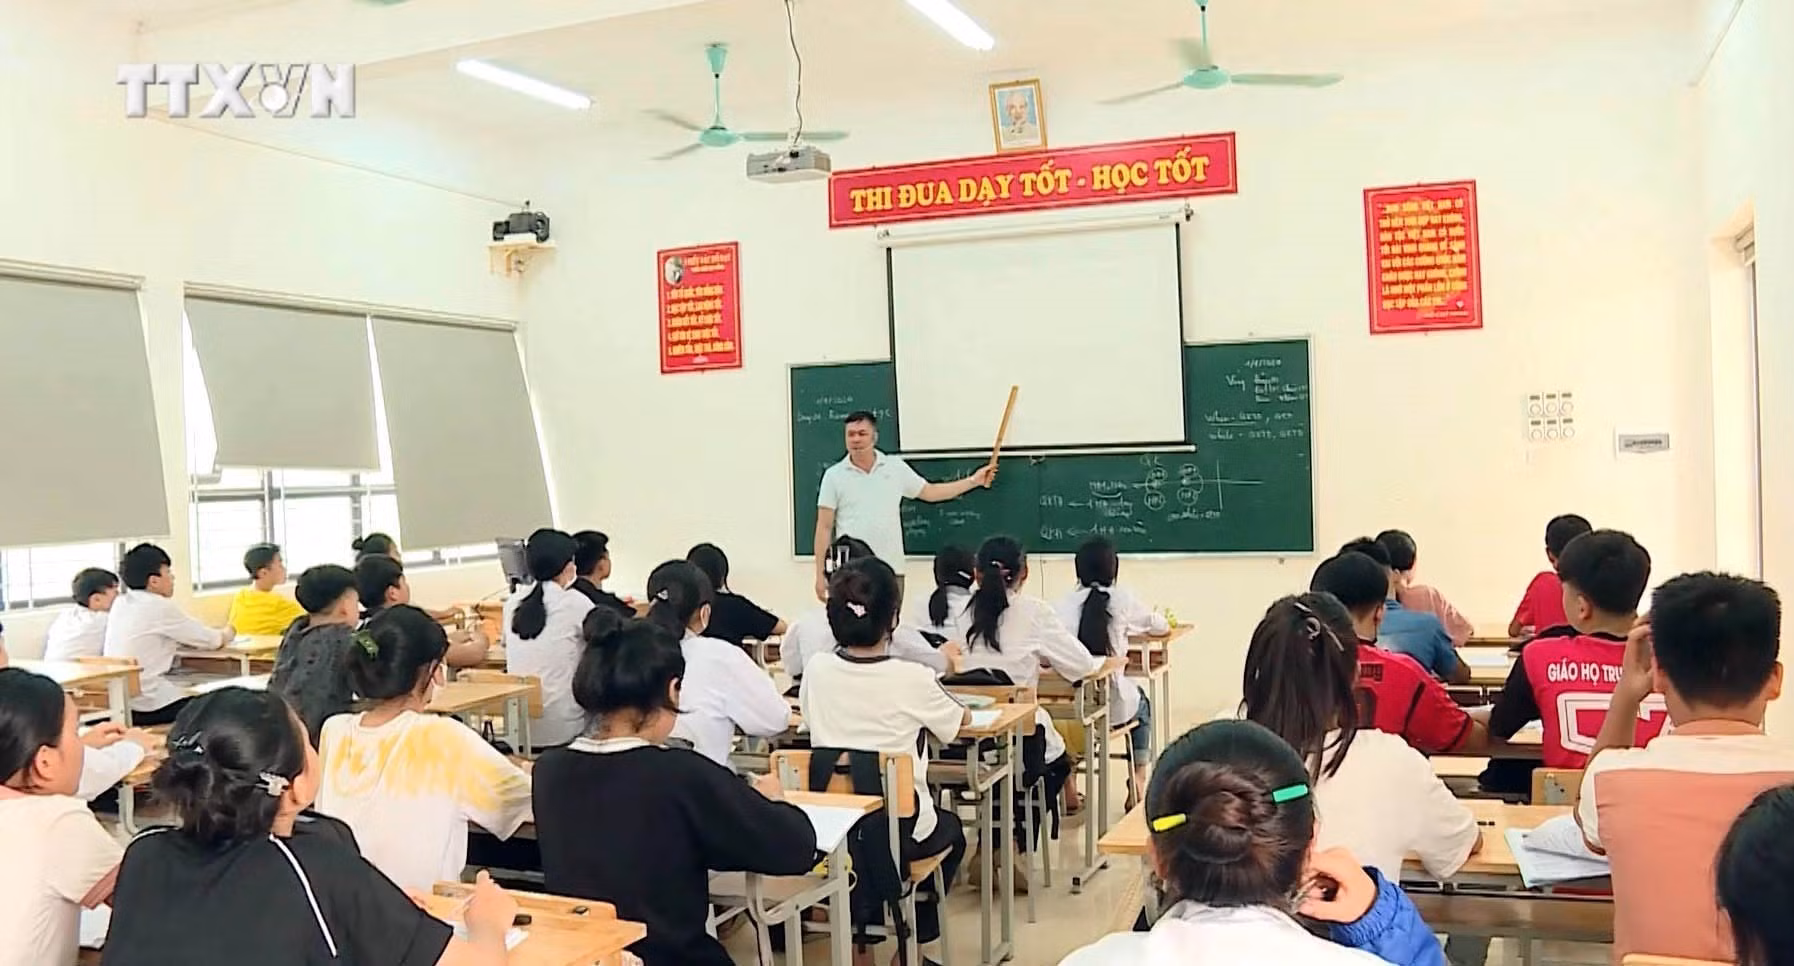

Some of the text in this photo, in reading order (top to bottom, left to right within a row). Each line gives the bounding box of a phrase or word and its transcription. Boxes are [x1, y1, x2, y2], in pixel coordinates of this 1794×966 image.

[850, 186, 893, 212] THI
[898, 180, 954, 208] ĐUA
[958, 174, 1014, 206] DẠY
[1020, 159, 1072, 196] TỐT
[1091, 161, 1149, 194] HỌC
[1154, 145, 1210, 185] TỐT
[1548, 657, 1578, 682] GIÁO
[1581, 662, 1600, 687] HỌ
